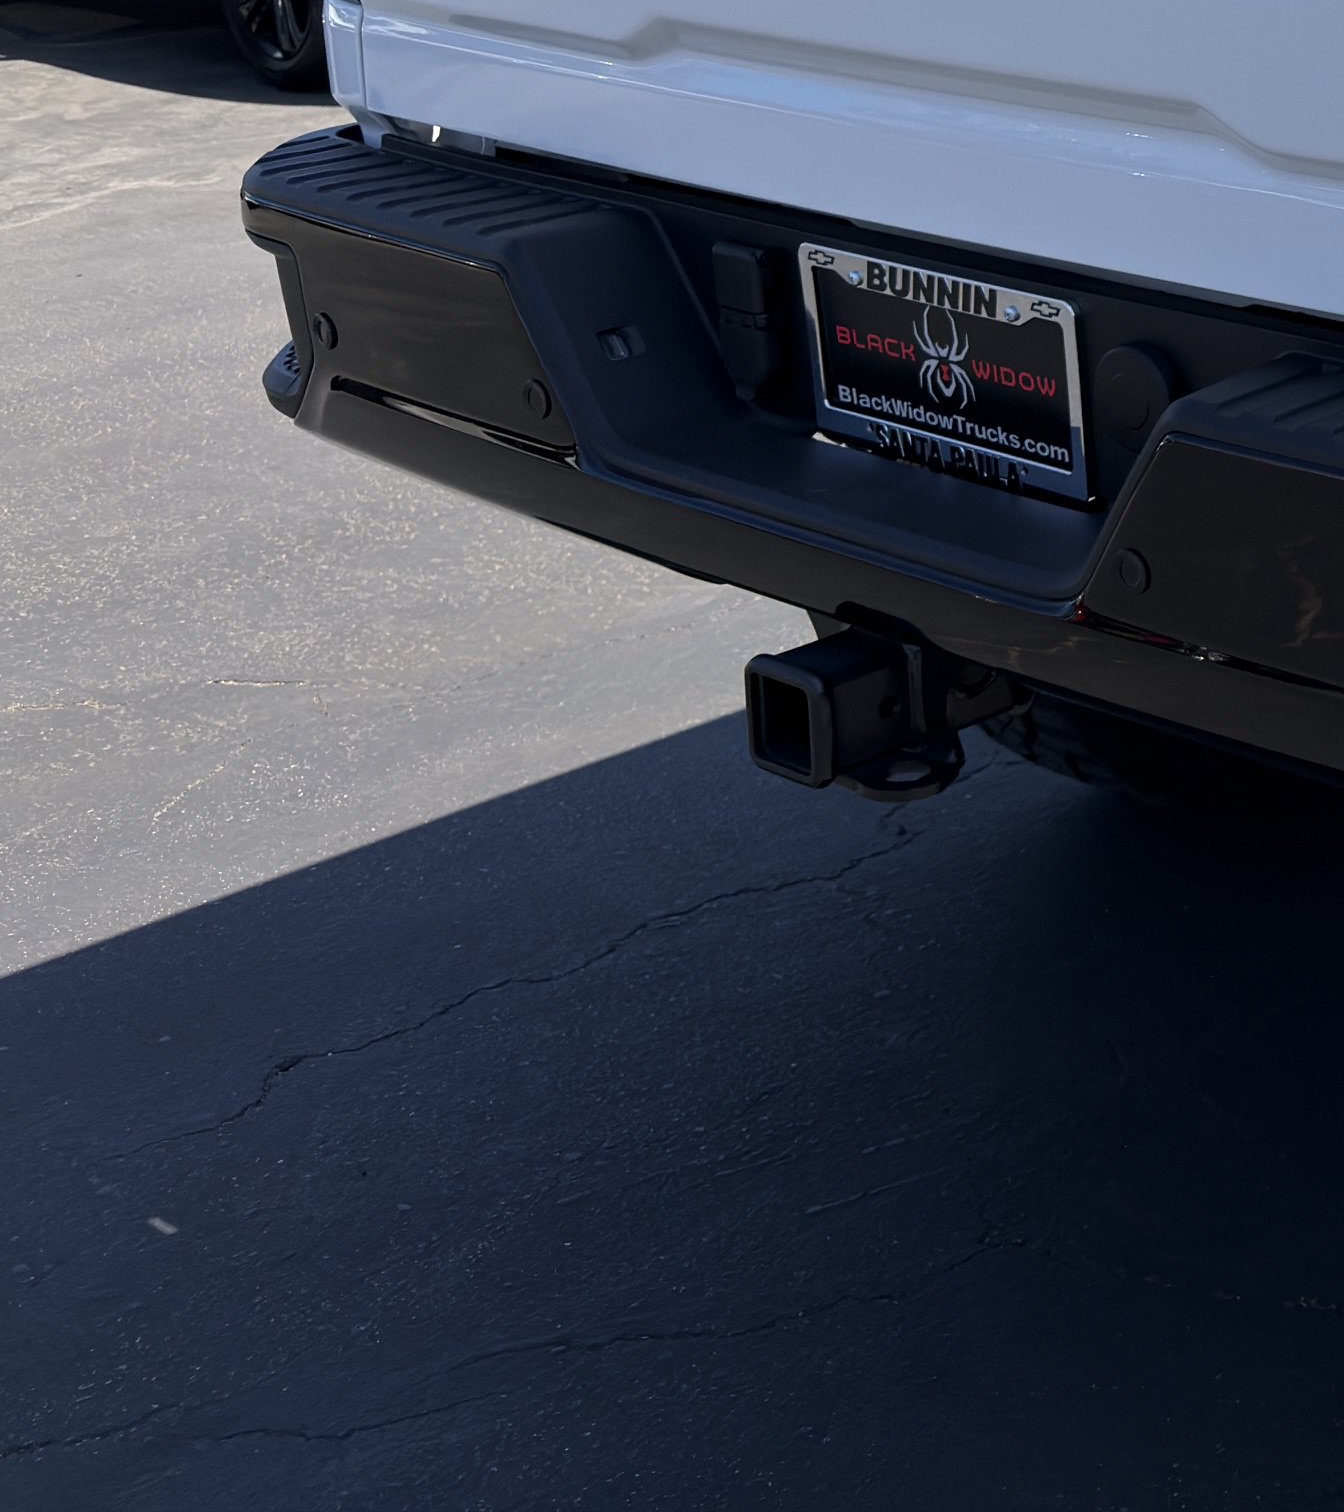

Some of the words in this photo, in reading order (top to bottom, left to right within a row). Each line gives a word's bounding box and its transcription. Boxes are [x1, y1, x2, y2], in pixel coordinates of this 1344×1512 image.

[866, 261, 998, 318] BUNNIN
[836, 324, 916, 362] BLACK
[971, 359, 1056, 398] WIDOW
[837, 384, 1070, 463] BlackWidowTrucks.com
